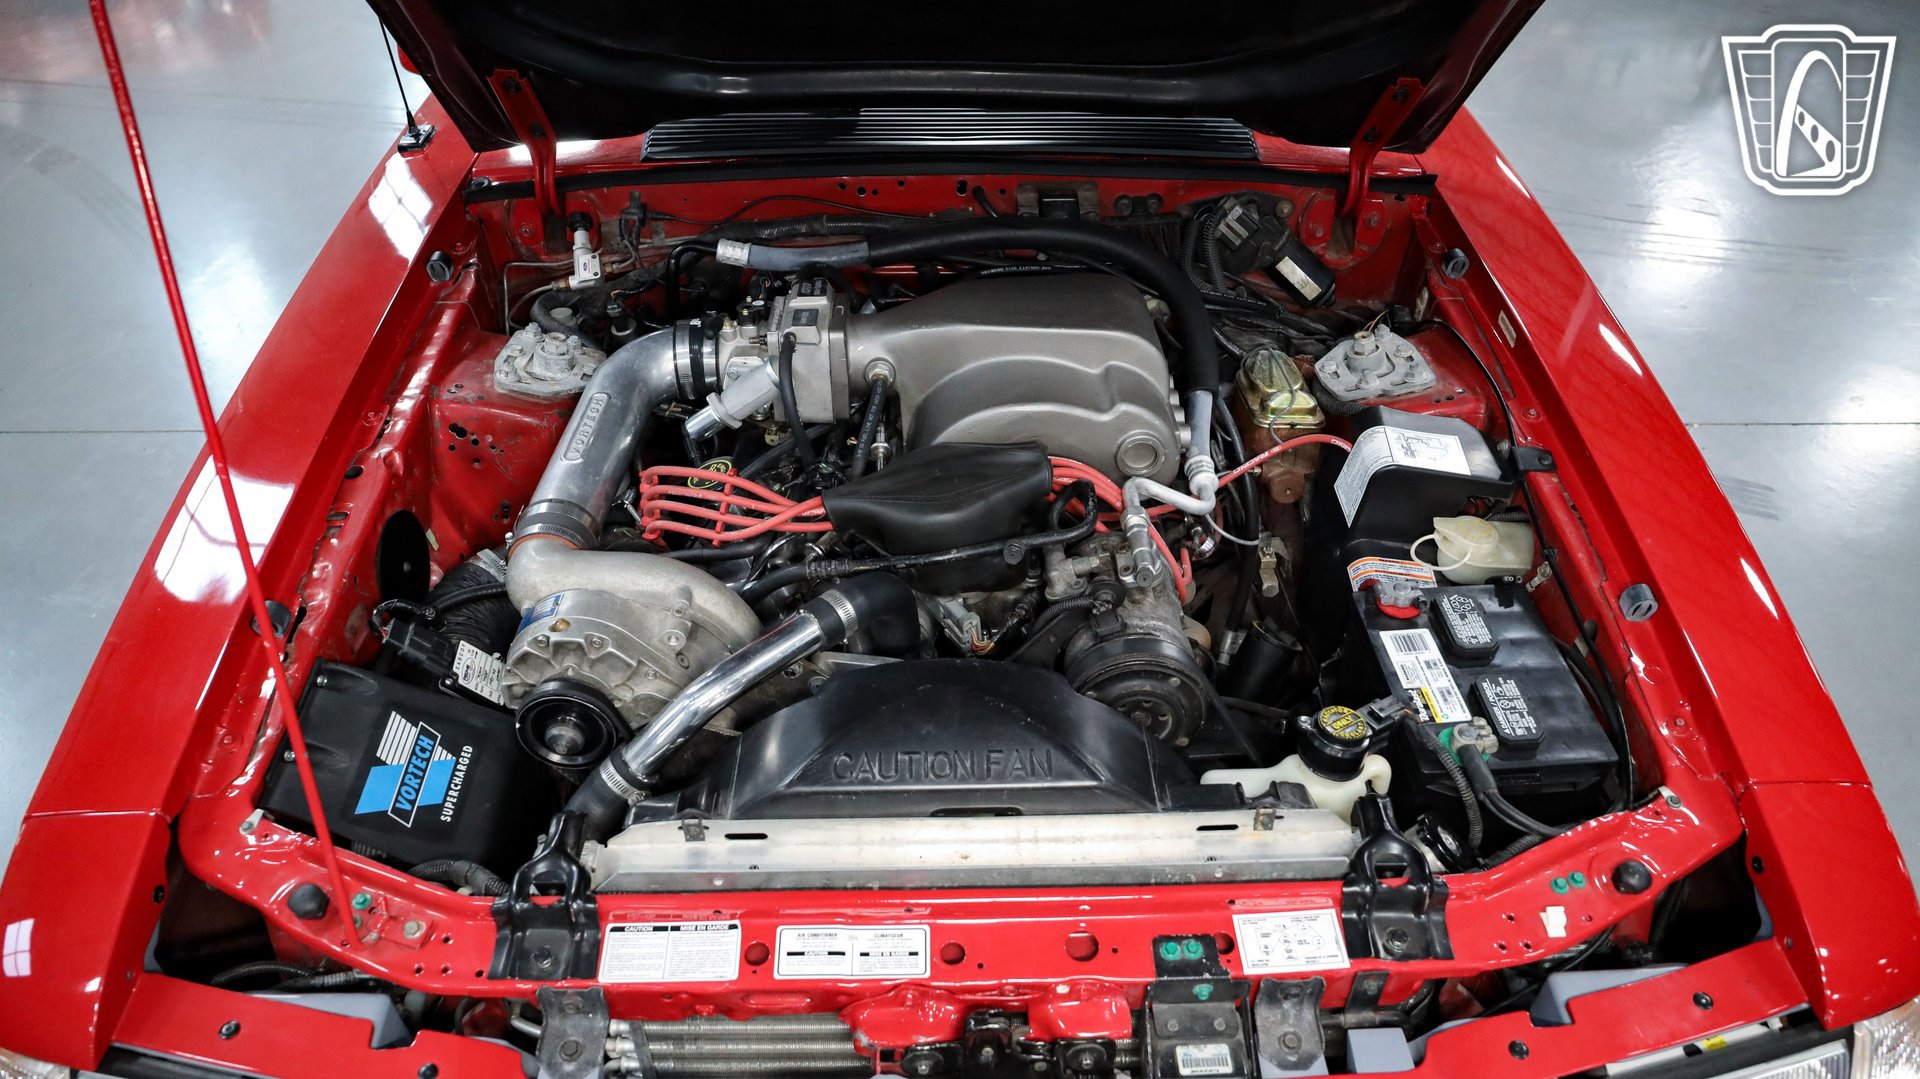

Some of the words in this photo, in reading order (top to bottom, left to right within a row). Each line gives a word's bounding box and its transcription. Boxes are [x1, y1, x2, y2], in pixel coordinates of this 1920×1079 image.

[570, 396, 605, 454] VORTECH
[1482, 682, 1494, 702] POISON
[1332, 715, 1354, 730] ONLY
[1494, 703, 1506, 730] DANGER
[395, 735, 435, 811] VORTECH
[832, 750, 975, 783] CAUTION
[985, 748, 1053, 780] FAN
[440, 745, 473, 822] SUPERCHARGED
